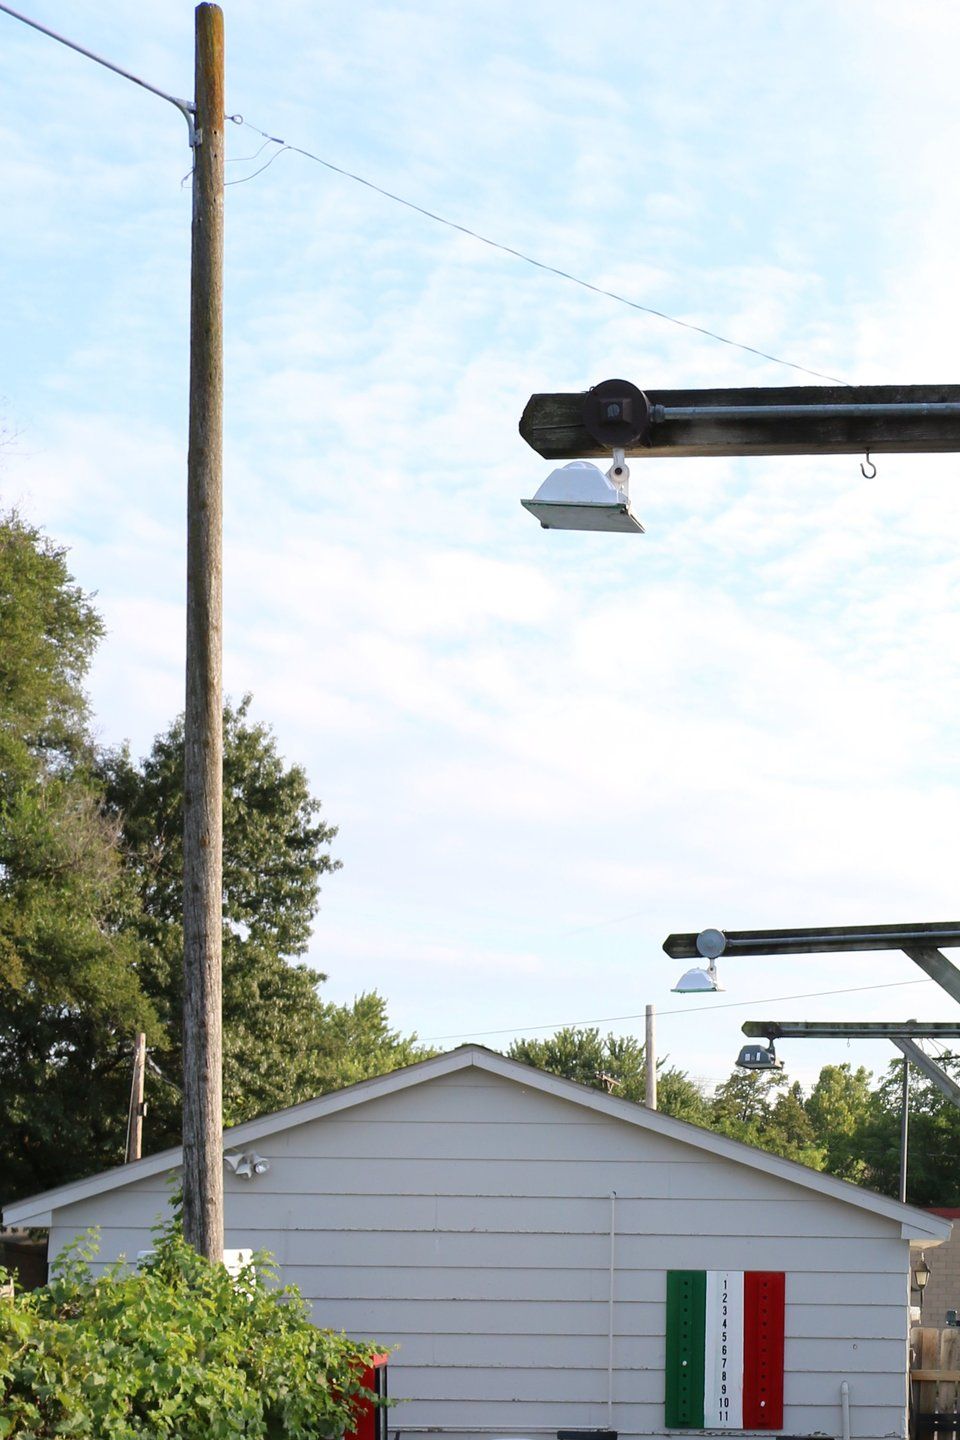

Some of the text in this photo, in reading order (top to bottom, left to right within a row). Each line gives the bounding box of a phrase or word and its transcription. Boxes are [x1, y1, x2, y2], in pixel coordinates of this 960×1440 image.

[723, 1279, 727, 1290] 1
[722, 1292, 728, 1303] 2
[722, 1305, 728, 1316] 3
[722, 1318, 727, 1329] 4
[722, 1331, 727, 1342] 5
[722, 1344, 728, 1356] 6
[722, 1358, 728, 1368] 7
[722, 1371, 727, 1382] 8
[721, 1384, 727, 1395] 9
[719, 1397, 729, 1408] 10
[718, 1410, 728, 1422] 11
